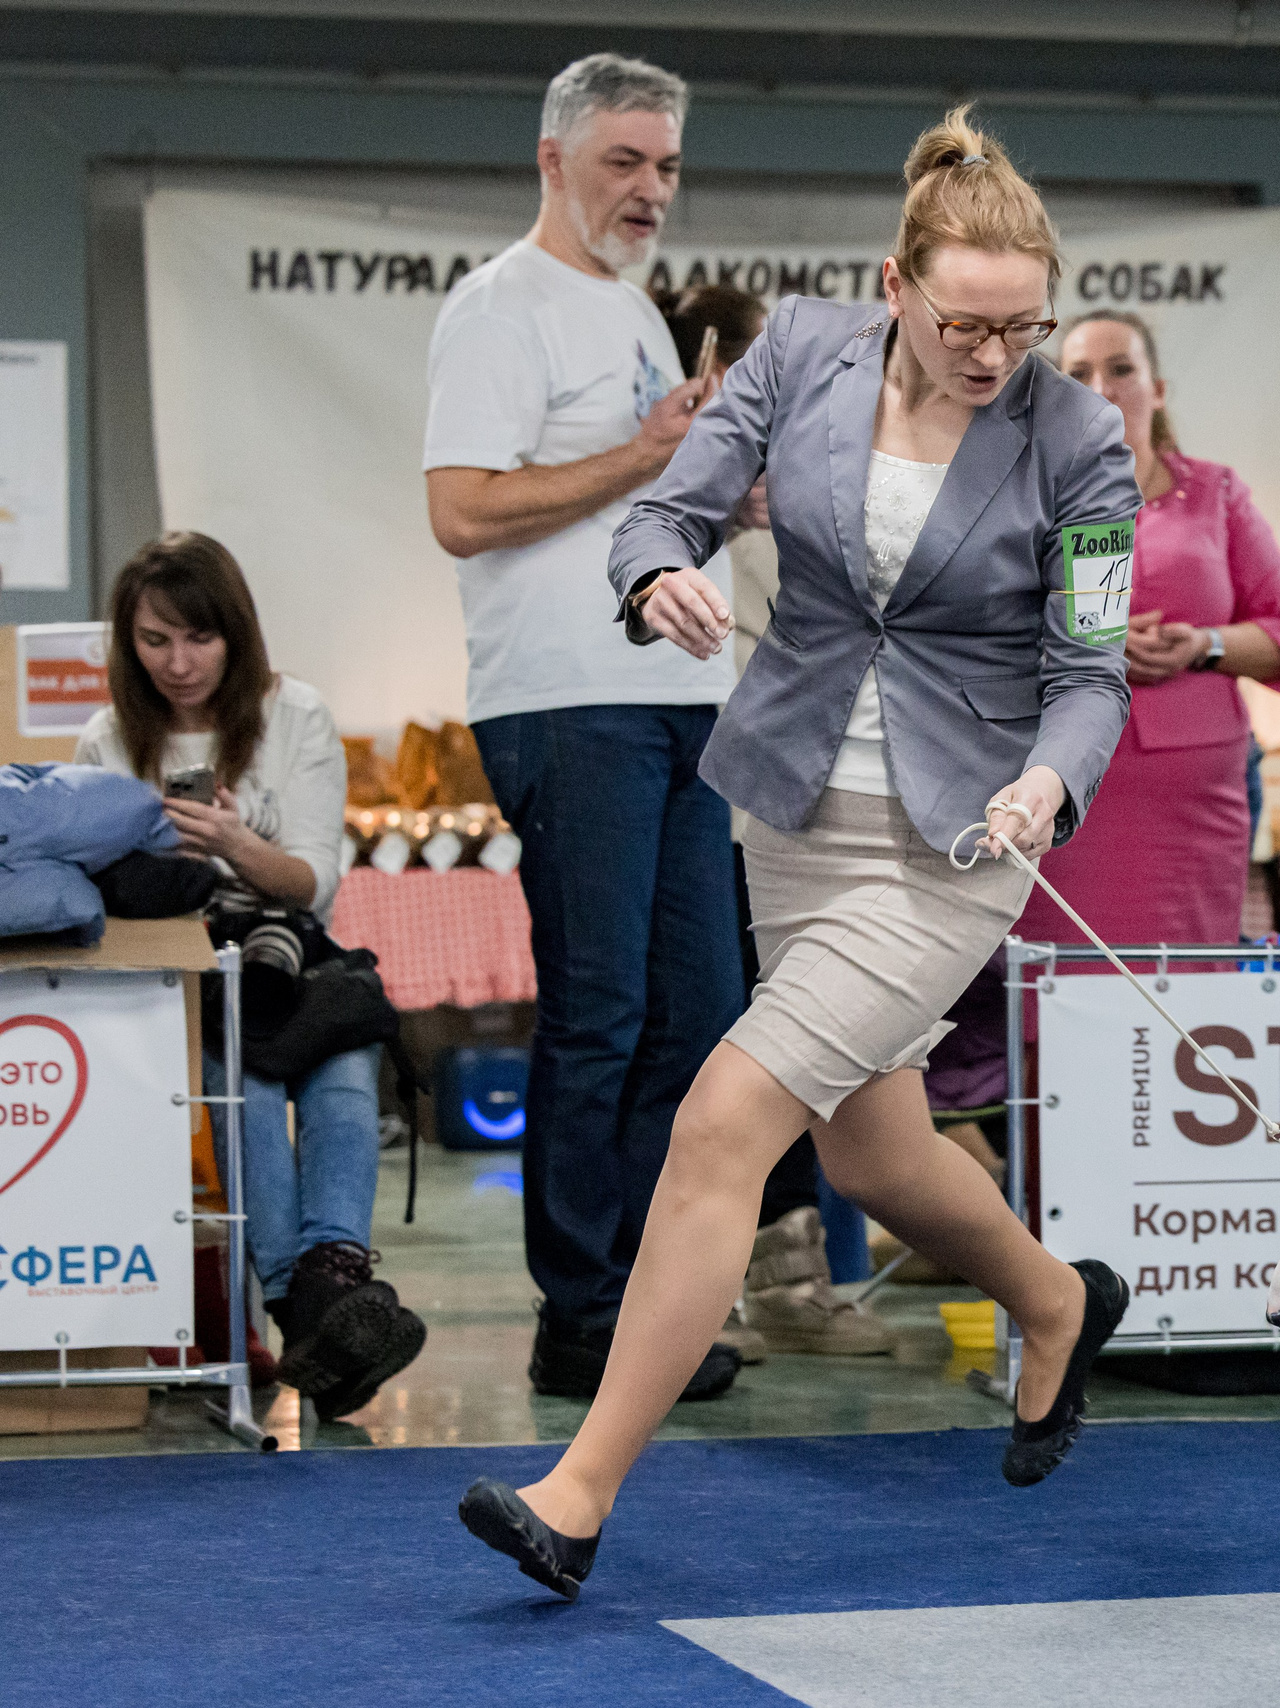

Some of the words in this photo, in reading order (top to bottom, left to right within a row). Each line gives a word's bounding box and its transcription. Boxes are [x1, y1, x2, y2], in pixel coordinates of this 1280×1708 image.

[250, 248, 490, 296] НАТУРАЛ
[1078, 260, 1226, 303] СОБАК
[1098, 552, 1130, 617] 17
[0, 1061, 63, 1085] ЭТО
[1132, 1025, 1151, 1147] PREMIUM
[1133, 1203, 1276, 1244] Корма
[1134, 1263, 1217, 1296] для
